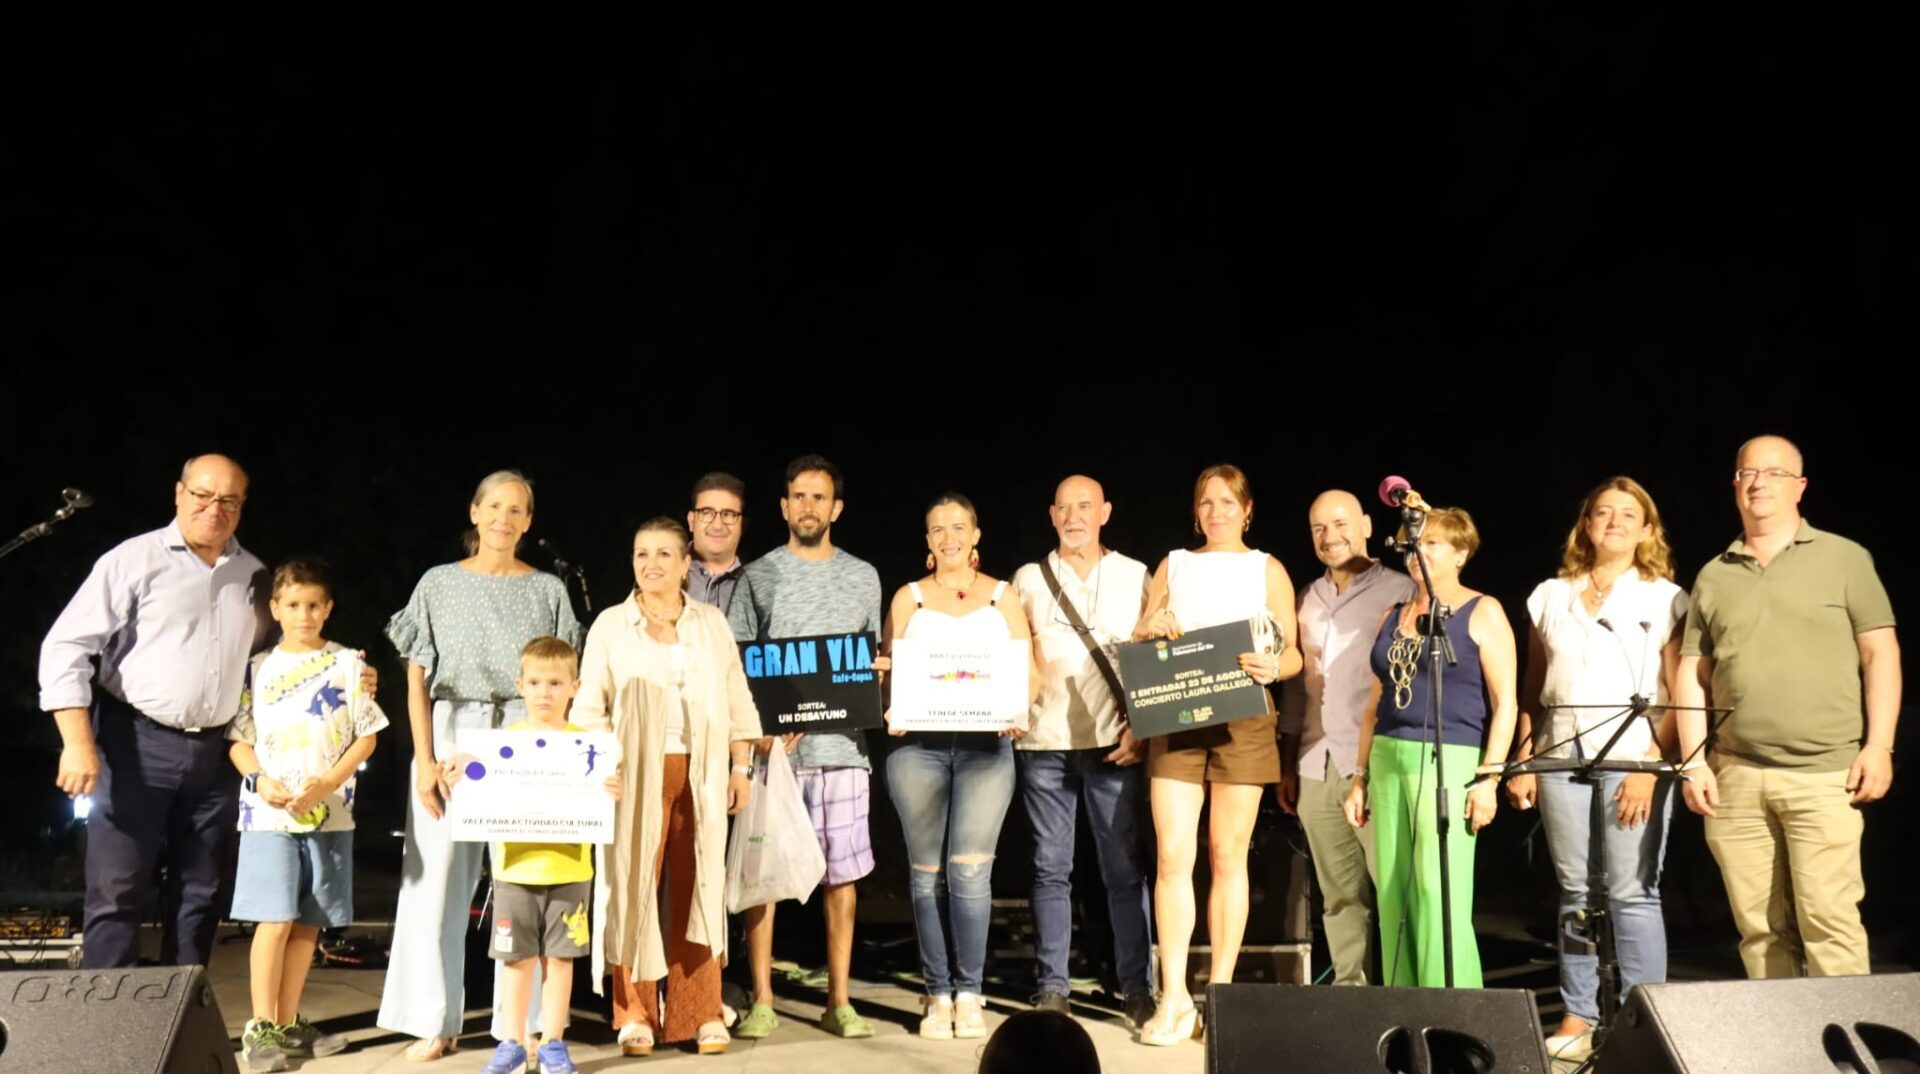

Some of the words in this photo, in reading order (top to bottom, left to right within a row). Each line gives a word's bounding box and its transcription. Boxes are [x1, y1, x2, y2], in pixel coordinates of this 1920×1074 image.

[745, 640, 817, 678] GRAN
[826, 634, 871, 672] VÍA
[1174, 669, 1204, 680] SORTEA:
[1130, 691, 1137, 699] 2
[1138, 681, 1186, 697] ENTRADAS
[1188, 679, 1199, 688] 23
[1201, 675, 1214, 685] DE
[1216, 670, 1247, 681] AGOST
[1134, 692, 1181, 708] CONCIERTO
[1183, 685, 1212, 699] LAURA
[1213, 678, 1253, 692] GALLEGO
[798, 701, 826, 711] SORTEA:
[778, 713, 793, 723] UN
[794, 709, 847, 722] DESAYUNO
[510, 818, 558, 826] ACTIVIDAD
[559, 819, 603, 827] CULTURAL
